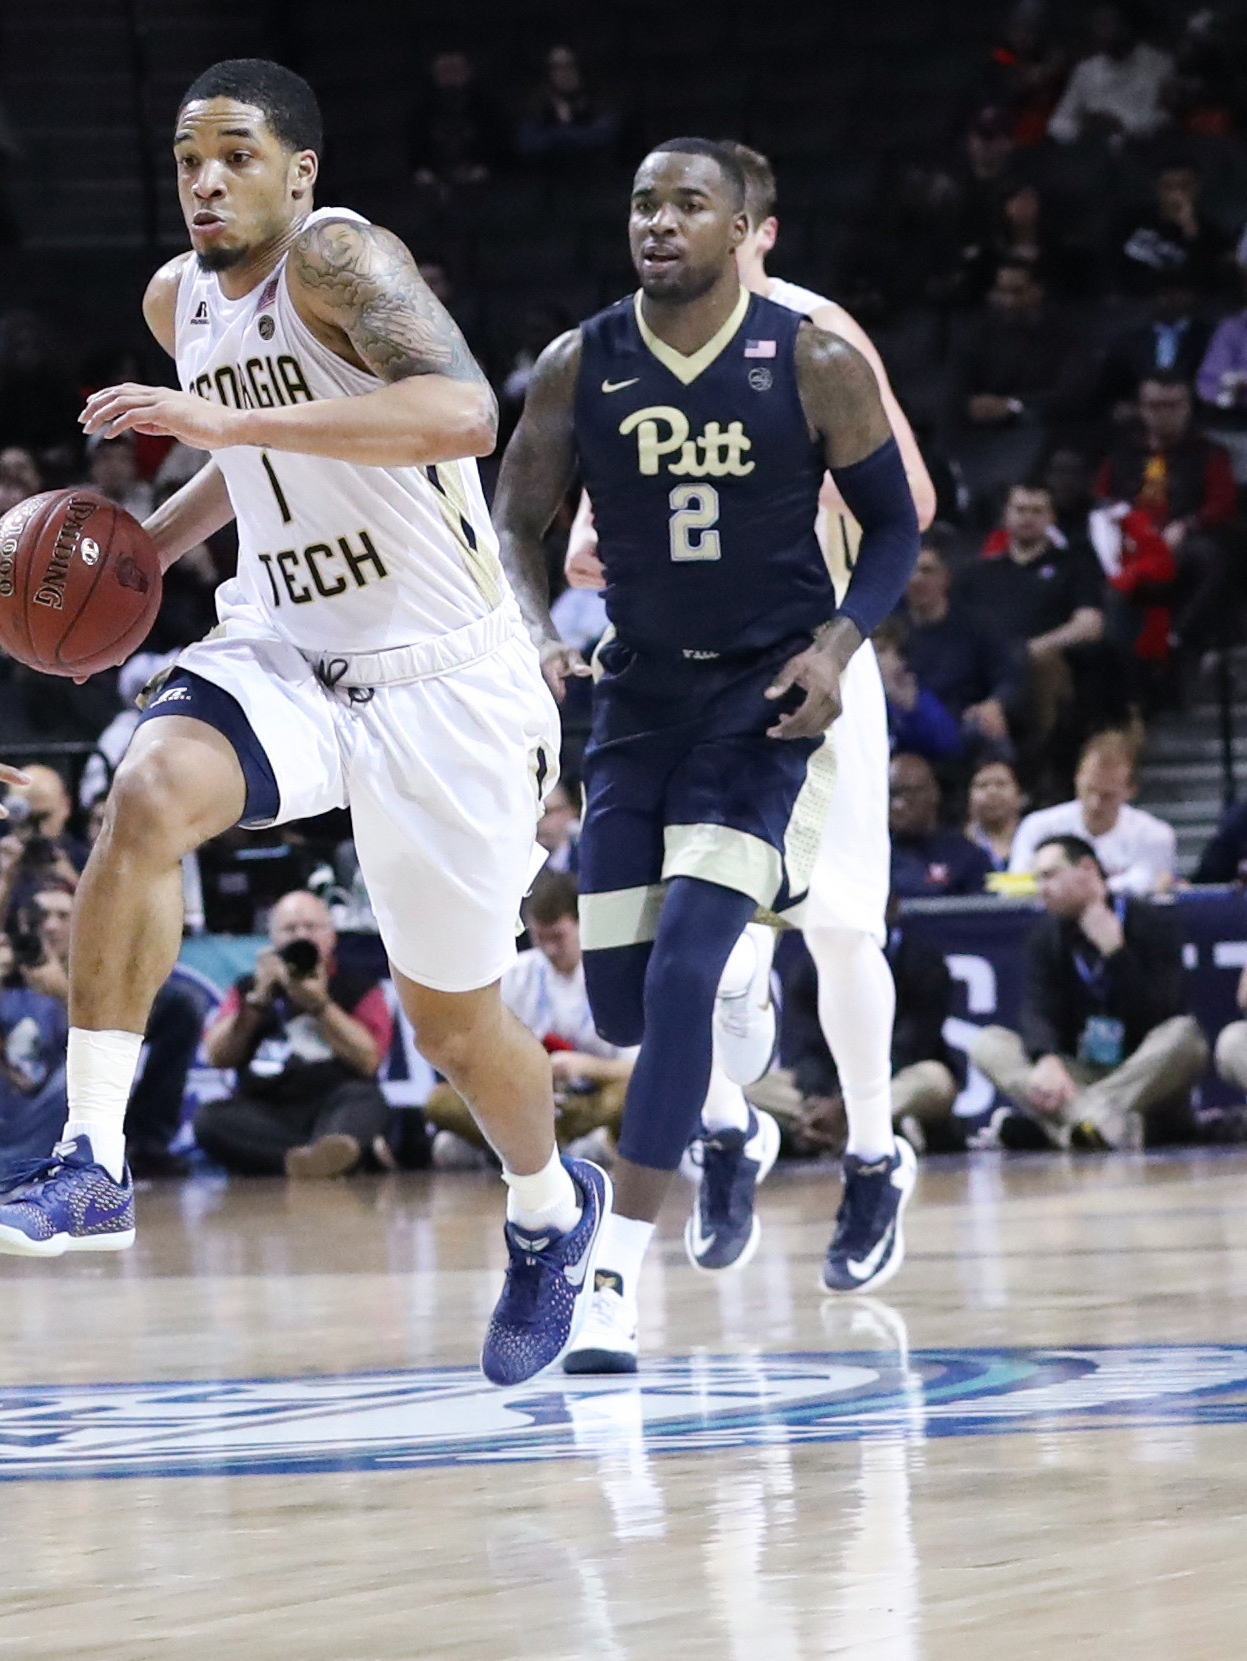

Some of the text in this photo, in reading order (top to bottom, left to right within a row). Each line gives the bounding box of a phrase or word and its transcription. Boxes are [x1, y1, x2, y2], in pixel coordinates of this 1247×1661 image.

[189, 355, 315, 410] EORGIA
[618, 404, 756, 477] Pitt
[260, 450, 292, 526] 1
[668, 482, 722, 562] 2
[33, 497, 100, 611] PALDING
[258, 530, 388, 608] TECH
